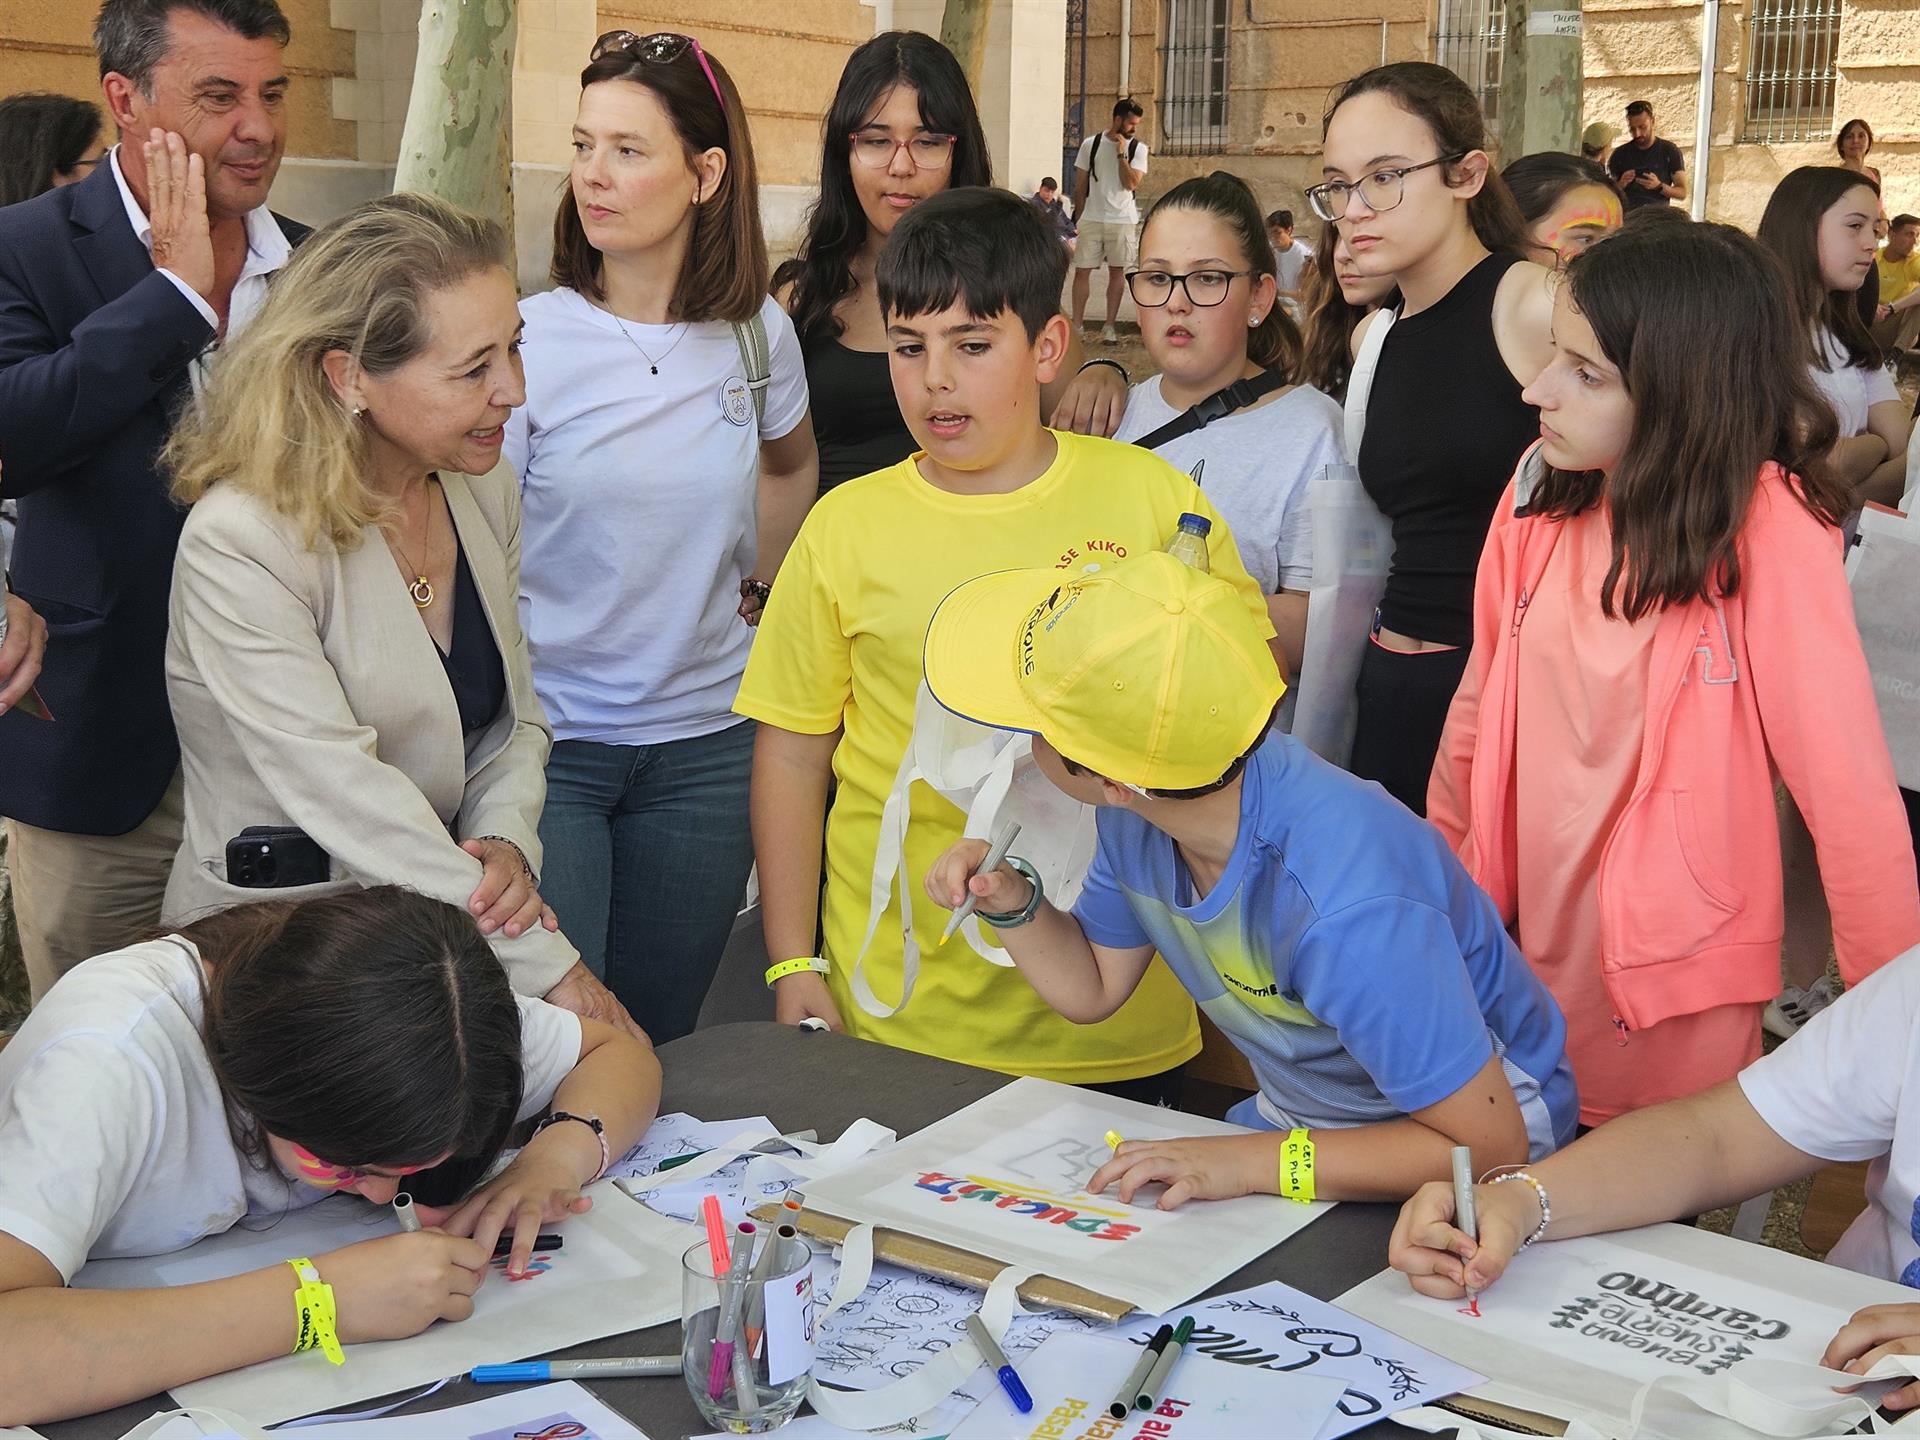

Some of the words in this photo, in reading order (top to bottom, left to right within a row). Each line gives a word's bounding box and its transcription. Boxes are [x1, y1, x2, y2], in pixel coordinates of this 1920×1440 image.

[1086, 540, 1127, 558] KIKO
[1289, 1143, 1298, 1155] EL
[1154, 1397, 1192, 1418] La
